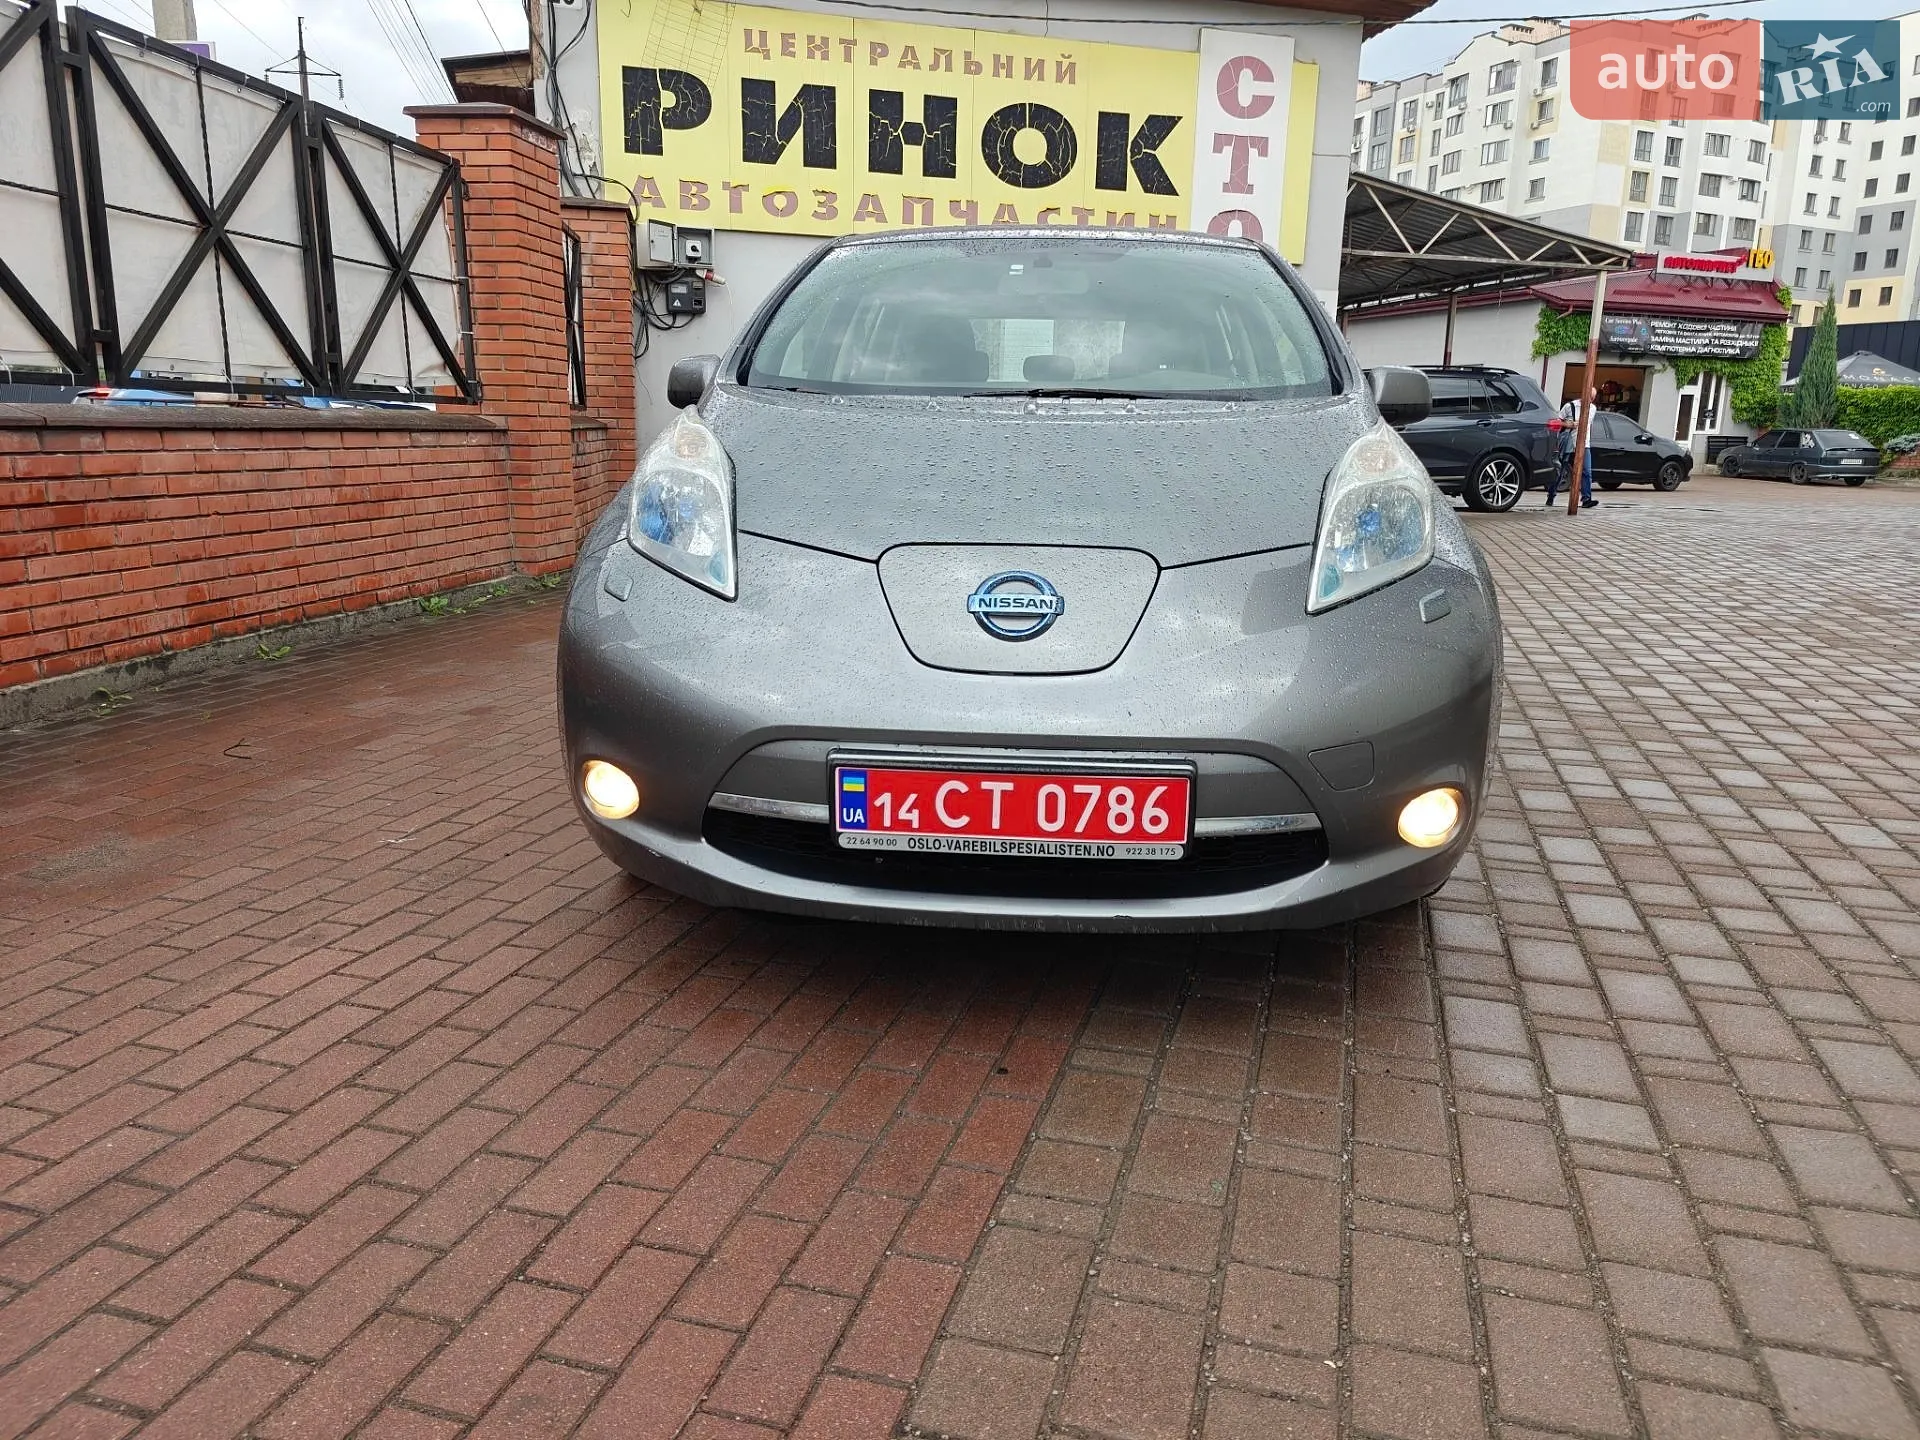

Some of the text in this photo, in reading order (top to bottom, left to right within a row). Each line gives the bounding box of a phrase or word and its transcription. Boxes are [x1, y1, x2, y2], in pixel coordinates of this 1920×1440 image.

[744, 28, 1077, 85] ЦЕНТРАЛЬНИЙ
[622, 65, 1184, 197] РИНОК
[978, 597, 1053, 610] NISSAN
[843, 780, 1169, 834] UA 14 CT 0786
[846, 837, 1176, 857] 22 64 90 00 OSLO-VAREBILSPESIALISTEN.NO 922 38 175
